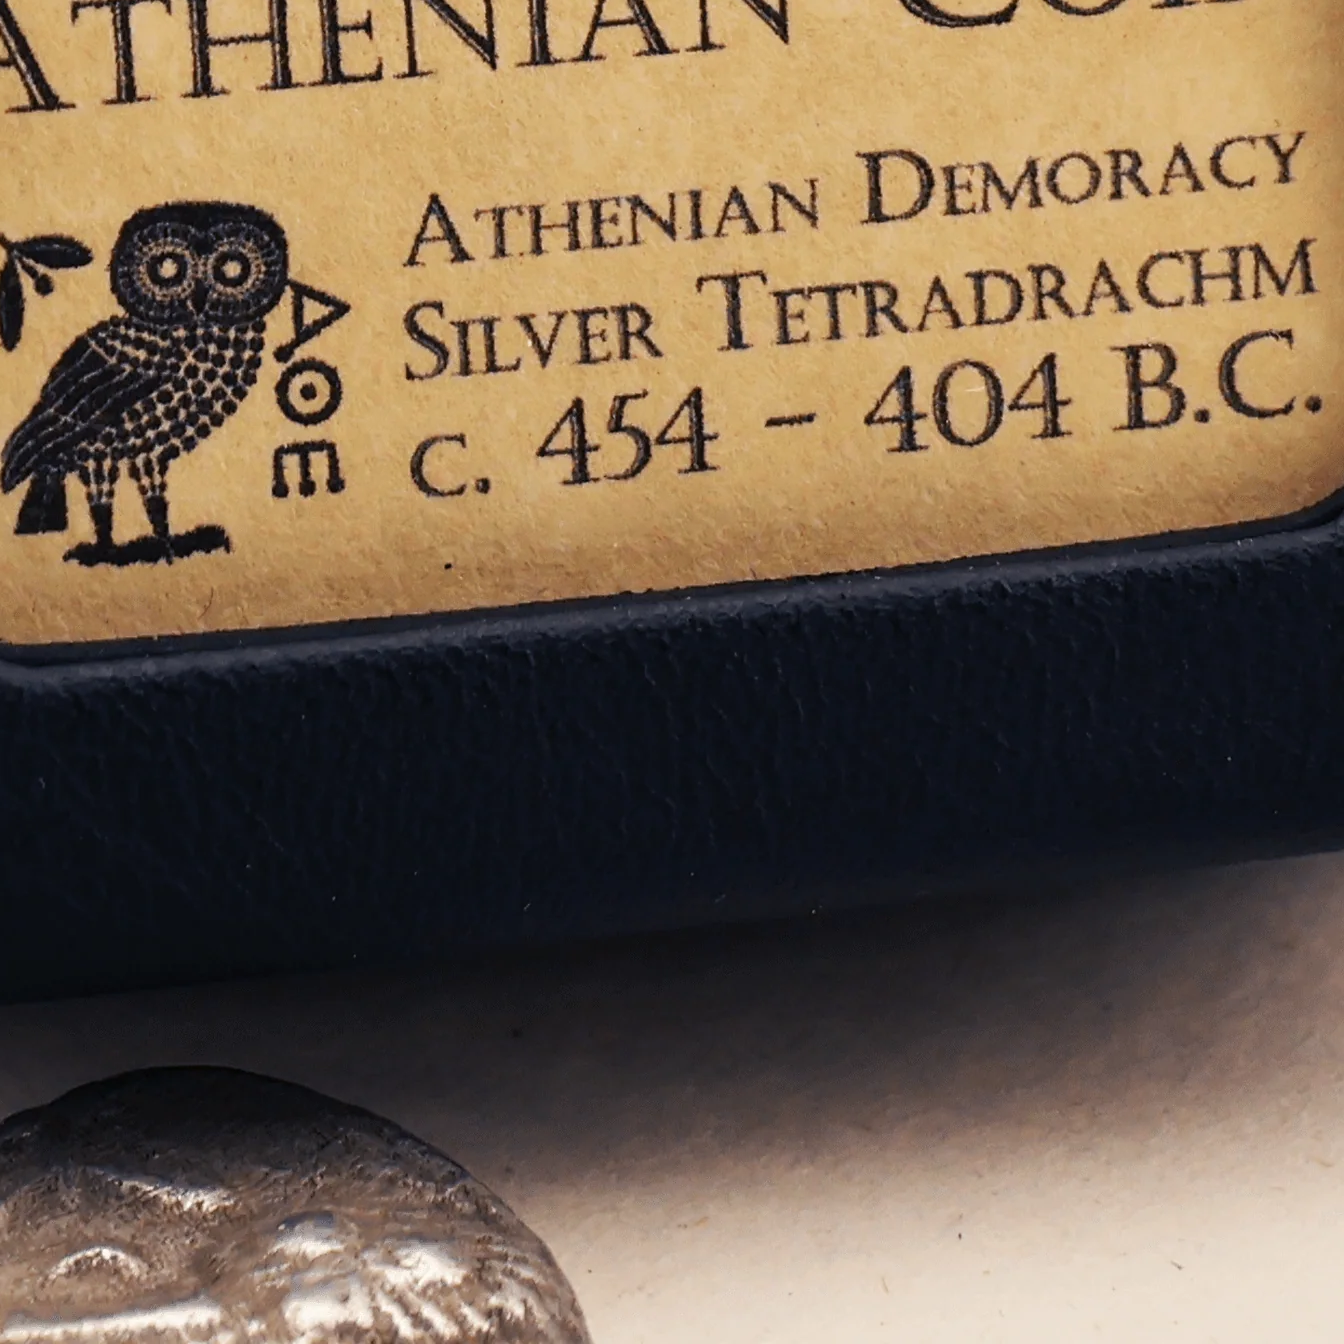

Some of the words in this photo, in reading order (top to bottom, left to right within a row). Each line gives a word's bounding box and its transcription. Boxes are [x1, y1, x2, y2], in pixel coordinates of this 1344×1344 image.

[402, 179, 819, 268] ATHENIAN
[855, 131, 1306, 225] DEMORACY
[403, 300, 664, 382] SILVER
[695, 237, 1318, 351] TETRADRACHM
[535, 386, 719, 486] 454
[863, 352, 1073, 454] 404
[1110, 328, 1323, 431] B.C.
